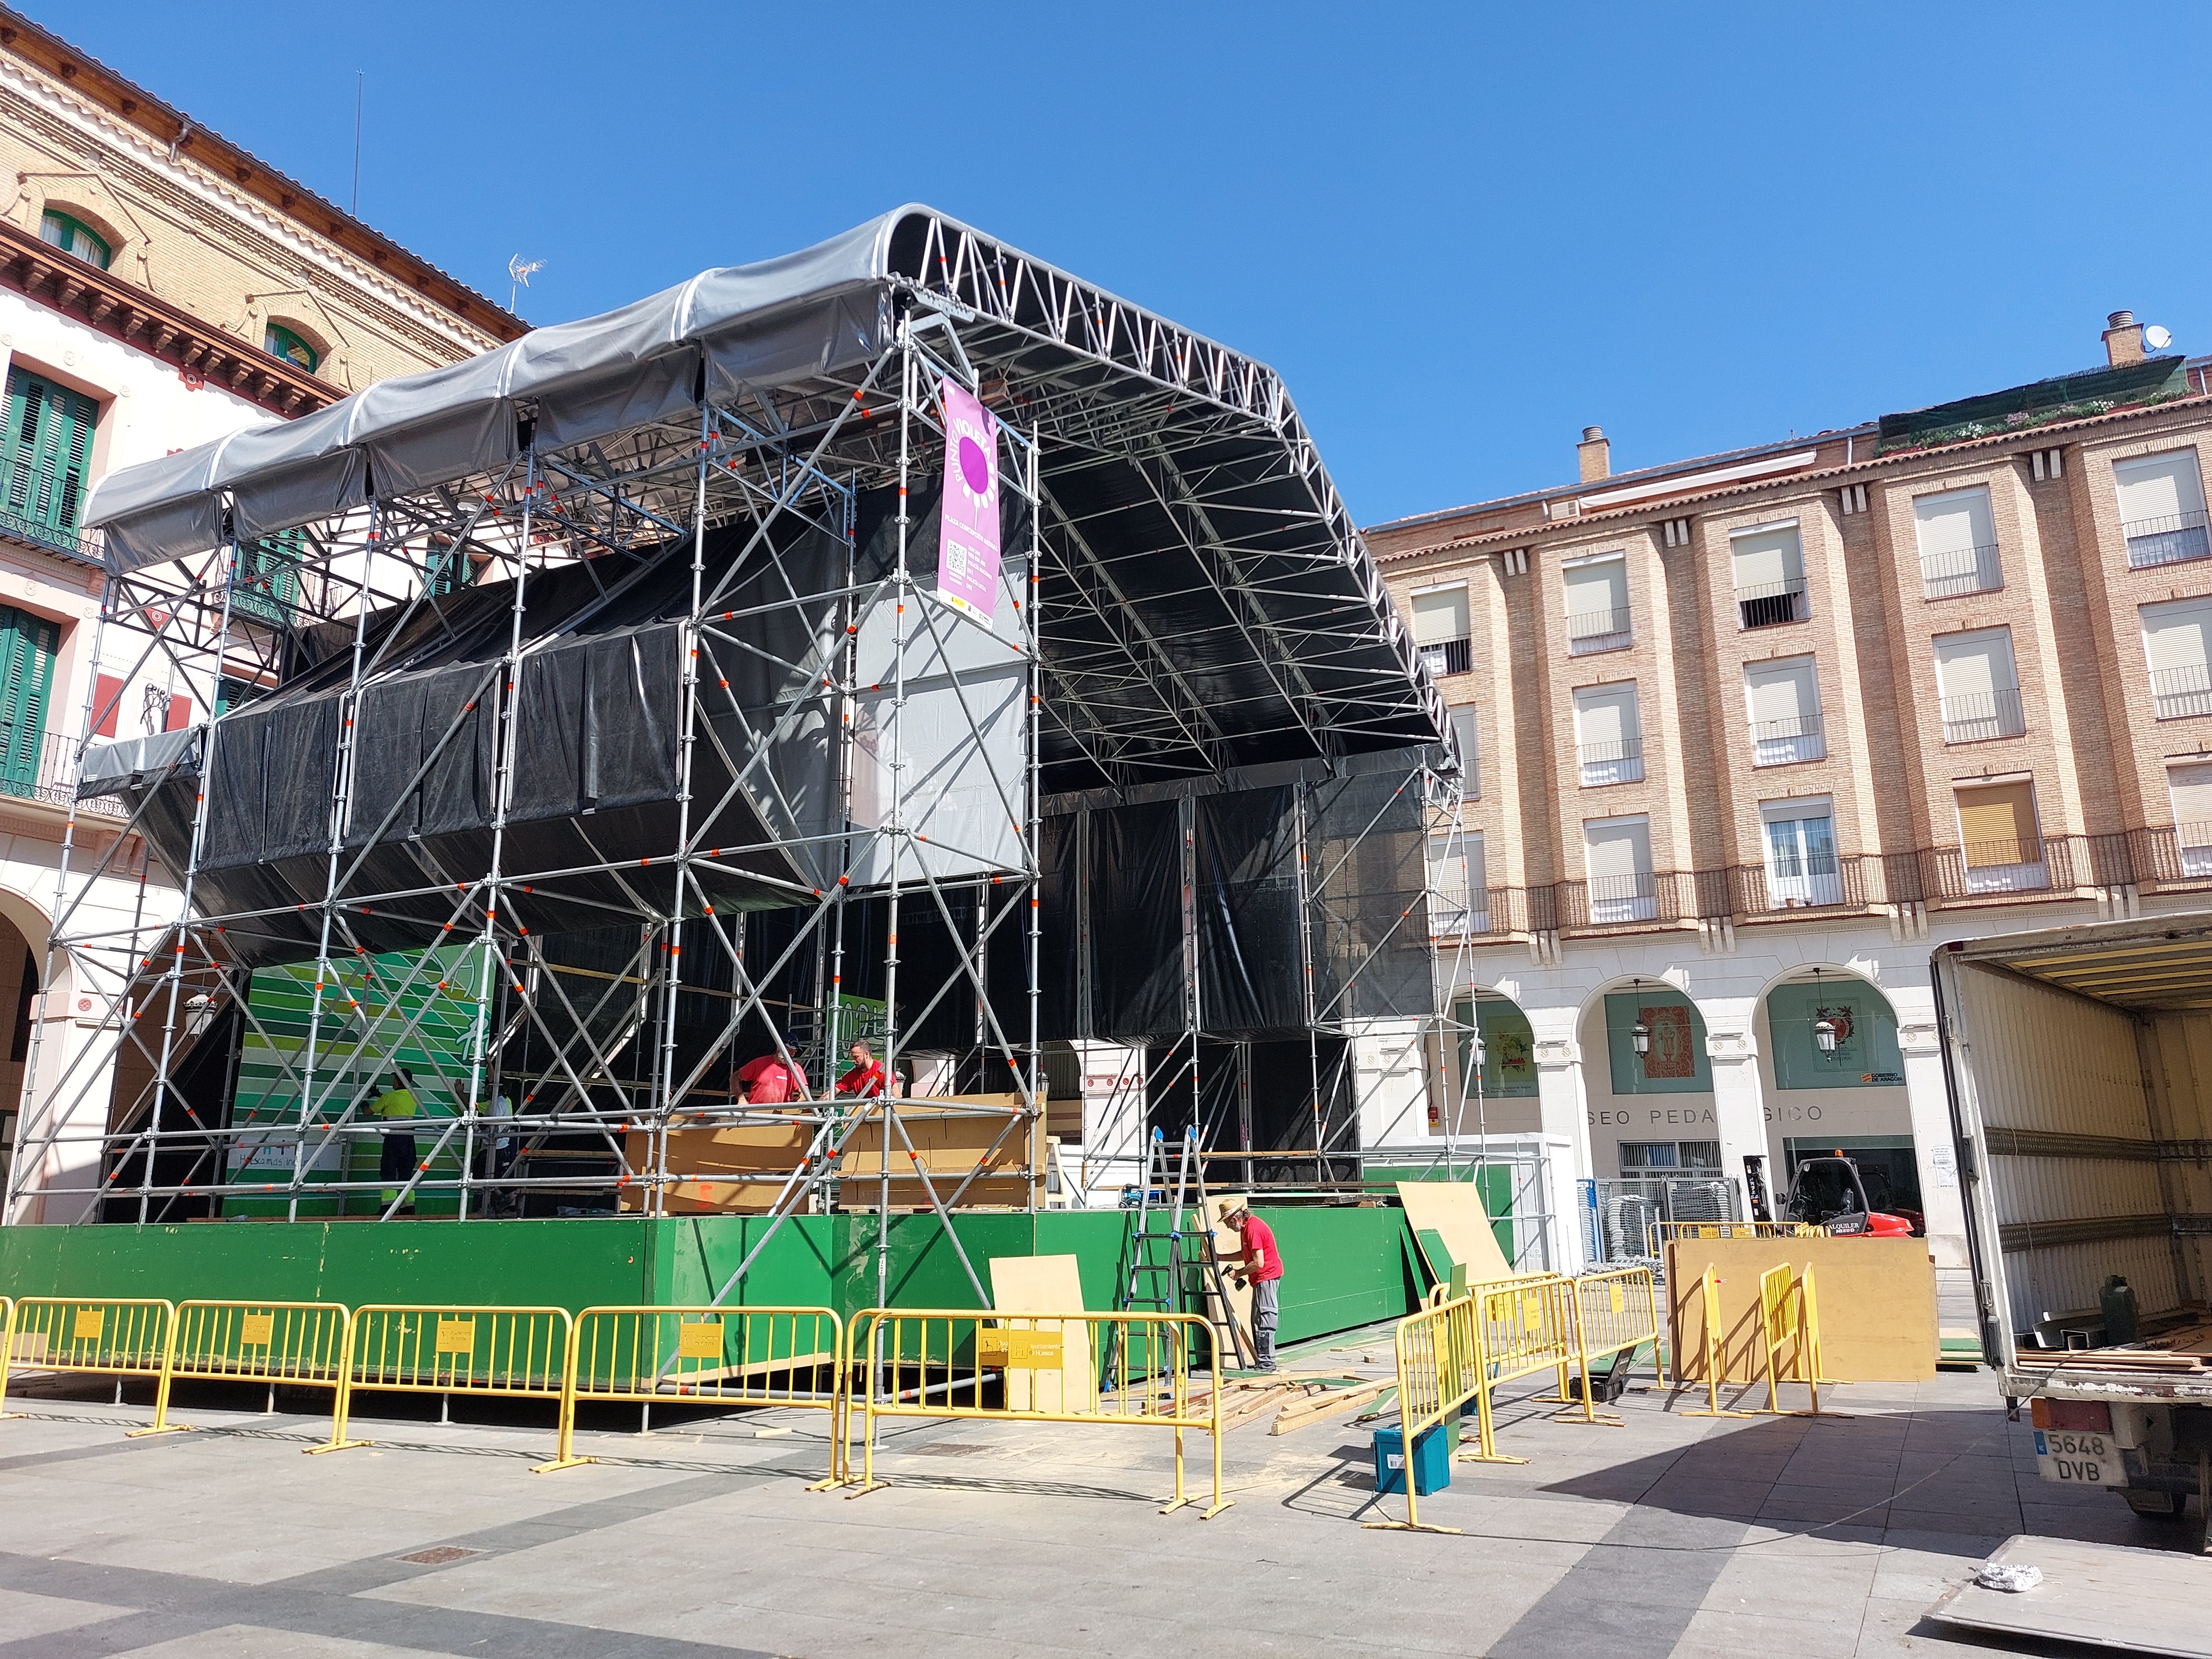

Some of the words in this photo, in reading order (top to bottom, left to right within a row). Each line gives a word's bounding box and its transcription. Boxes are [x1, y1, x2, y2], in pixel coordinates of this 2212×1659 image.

[952, 418, 991, 462] VIOLETA
[950, 429, 963, 483] PUNTO
[240, 1154, 264, 1165] Hesca
[2048, 1434, 2105, 1455] 5648
[2058, 1460, 2100, 1482] DVB
